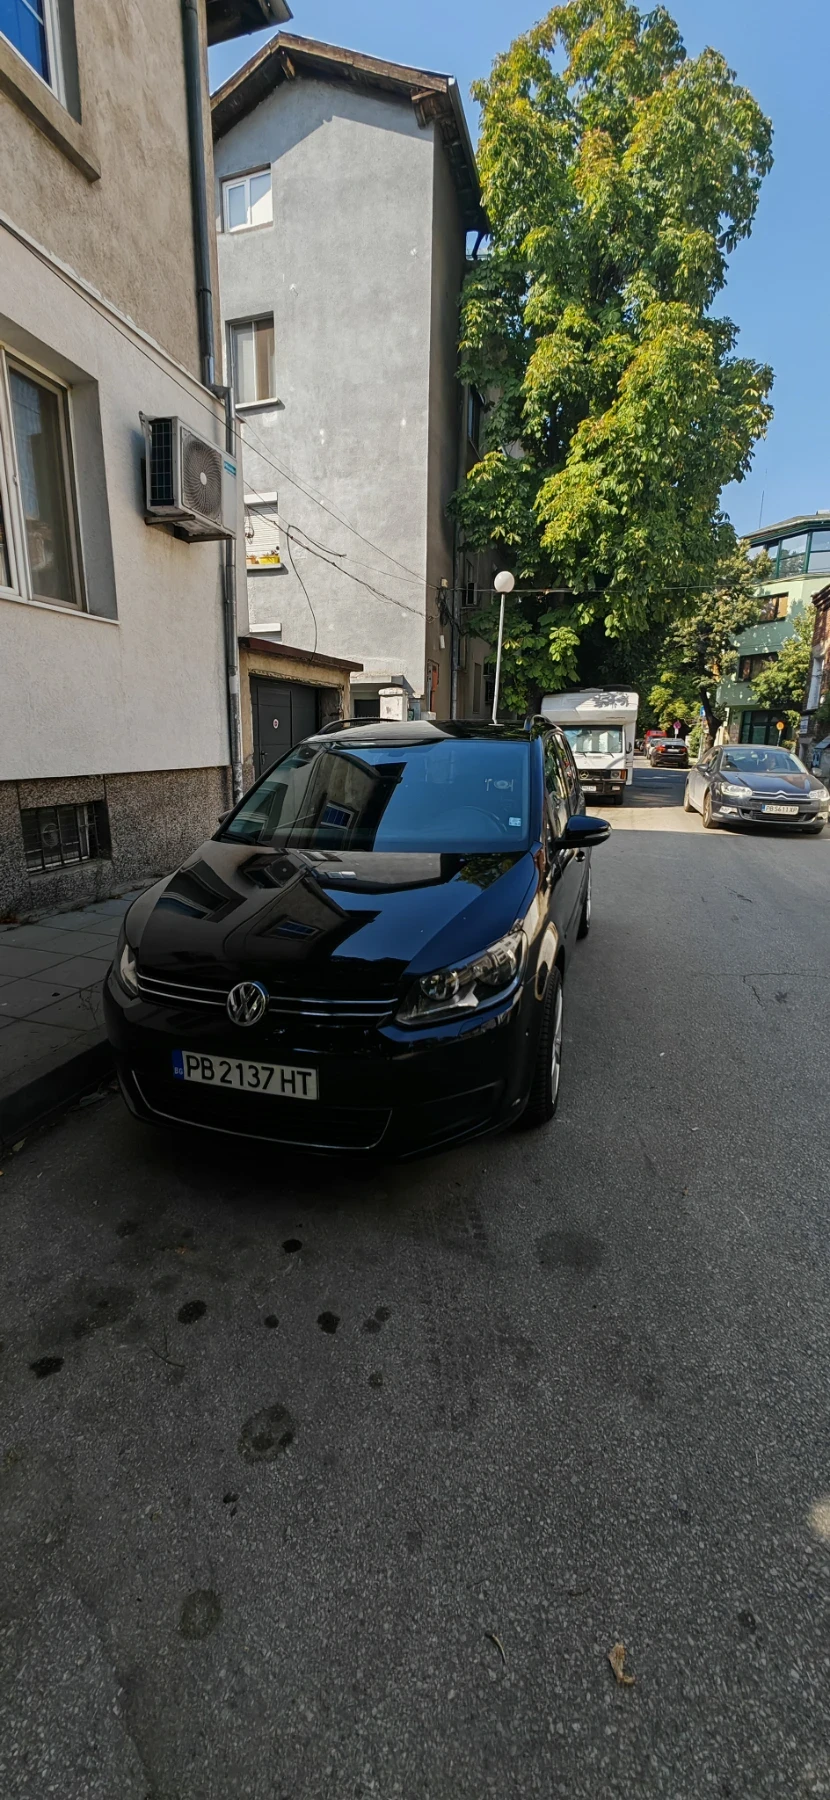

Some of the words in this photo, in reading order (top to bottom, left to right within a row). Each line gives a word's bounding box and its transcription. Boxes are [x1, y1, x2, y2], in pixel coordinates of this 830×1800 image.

[174, 1066, 184, 1076] BG
[185, 1054, 215, 1081] PB
[219, 1060, 275, 1090] 2137
[280, 1068, 312, 1096] HT
